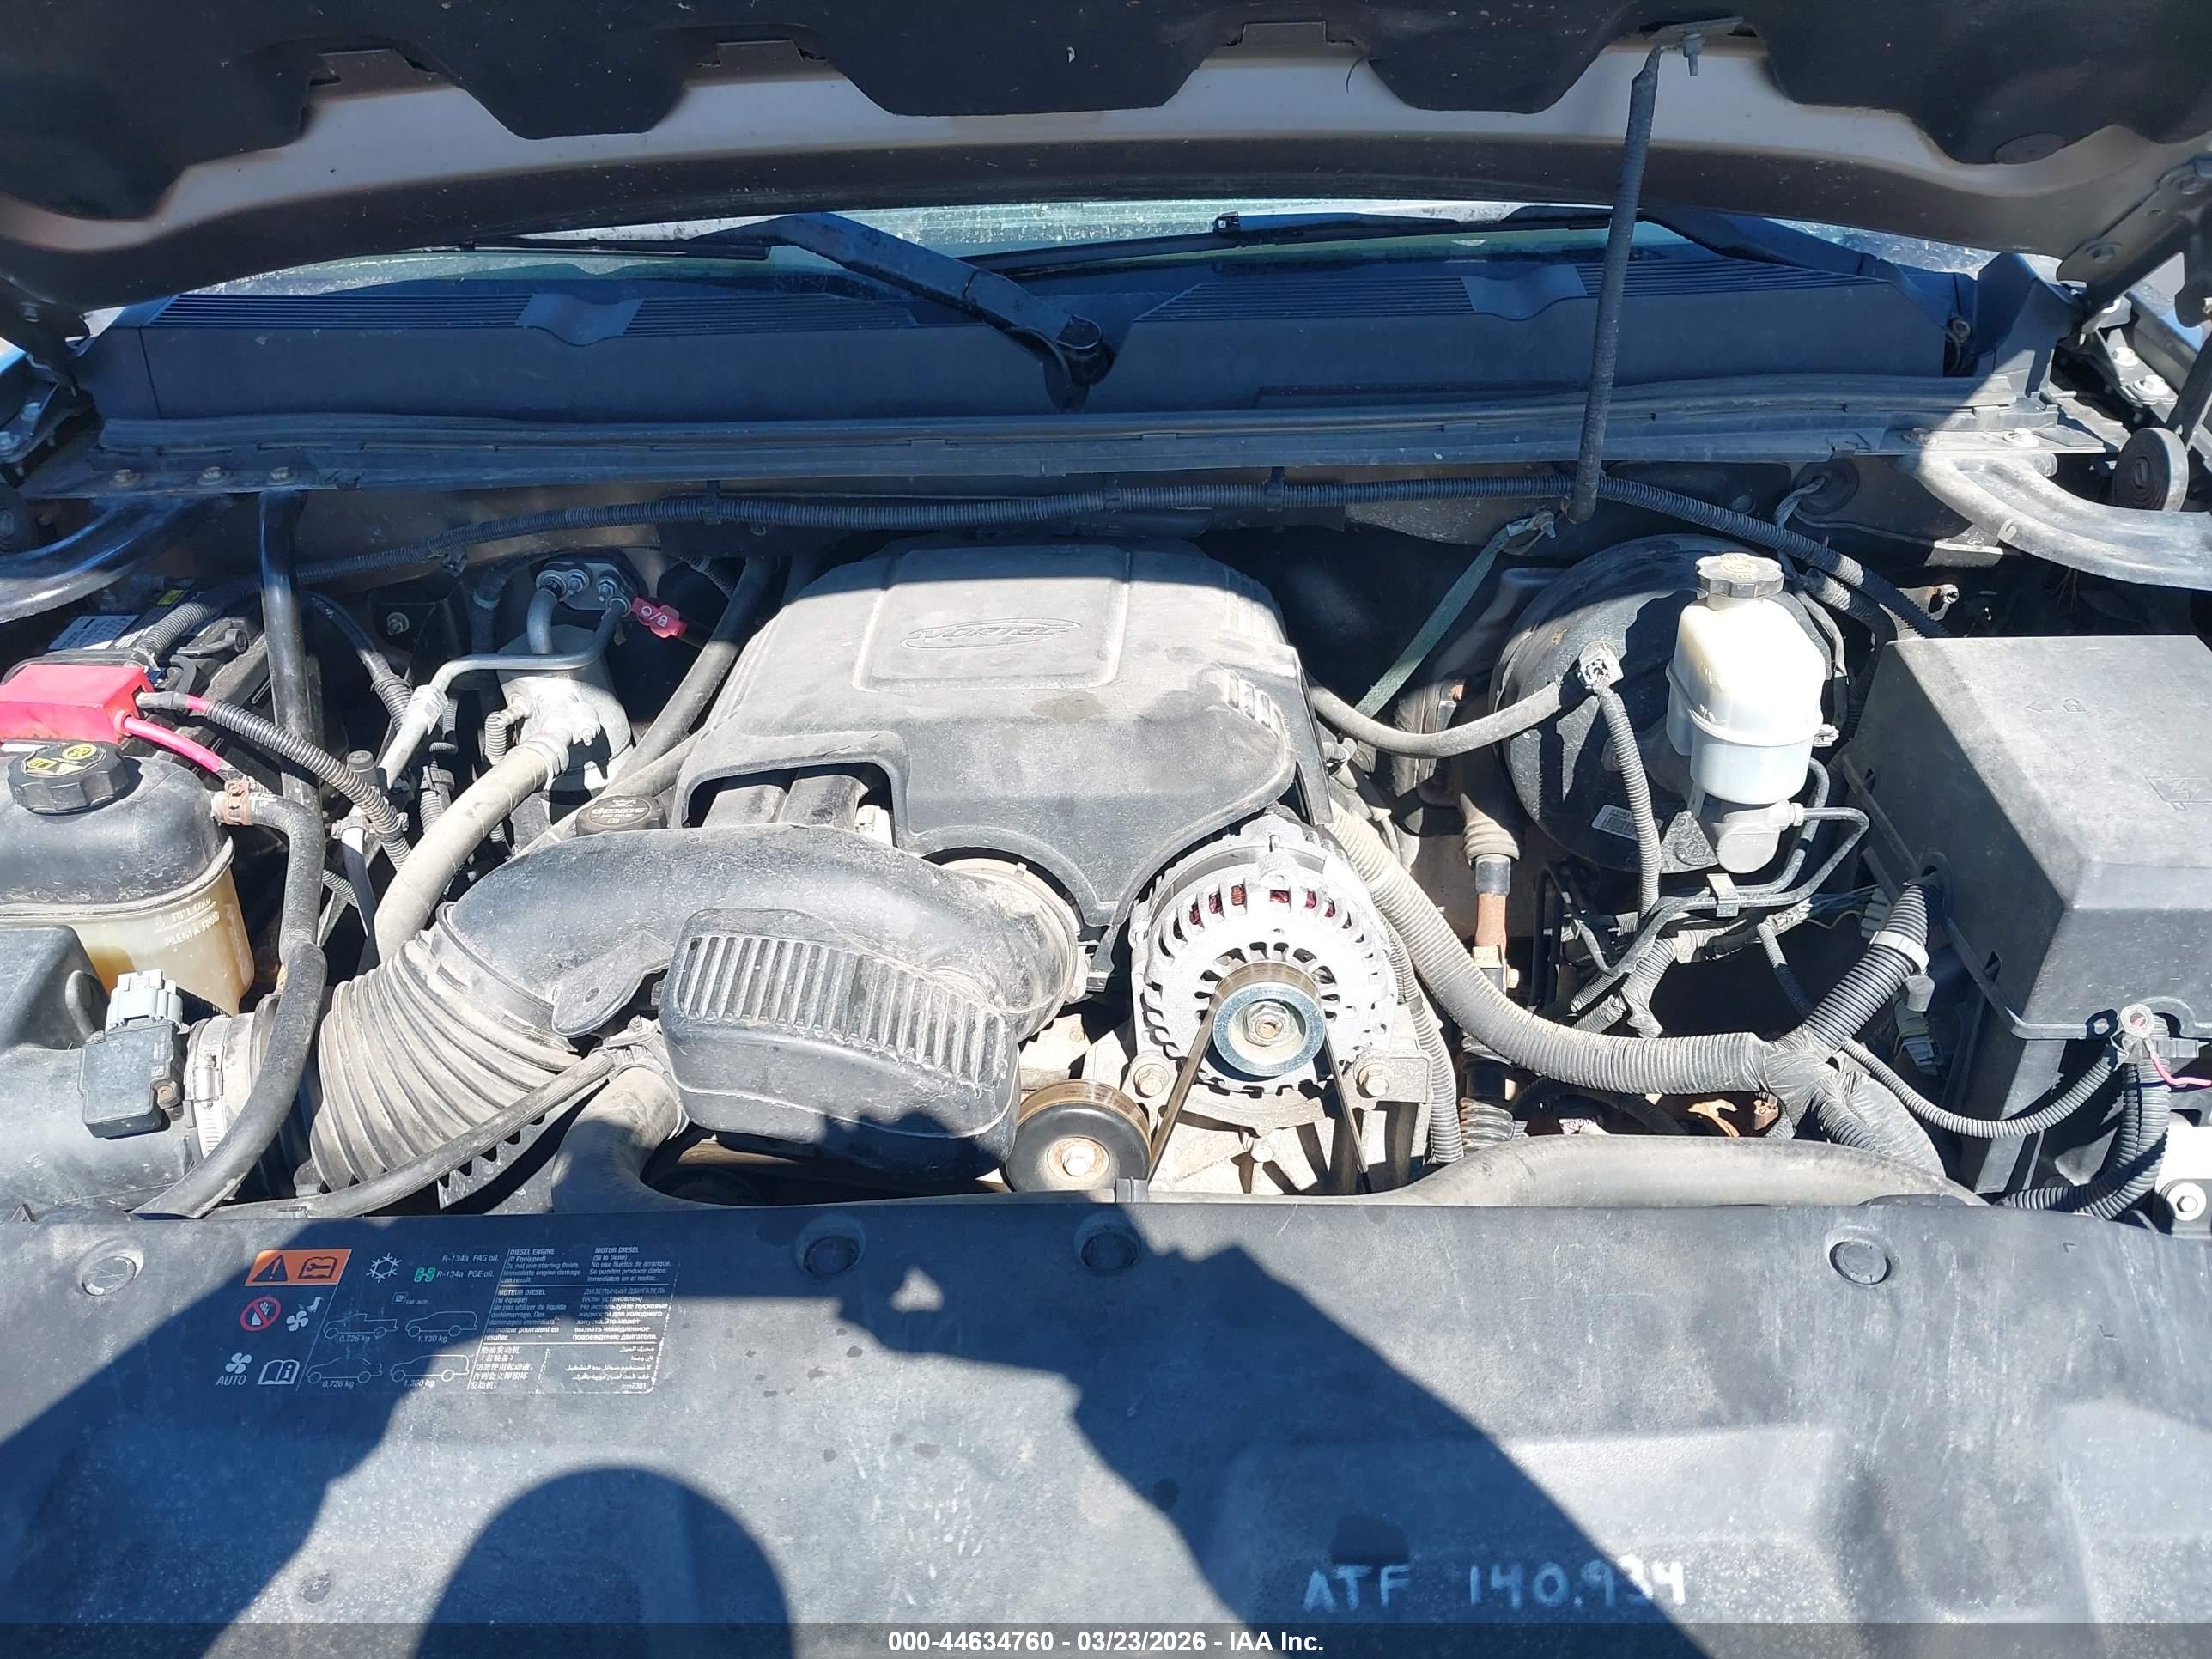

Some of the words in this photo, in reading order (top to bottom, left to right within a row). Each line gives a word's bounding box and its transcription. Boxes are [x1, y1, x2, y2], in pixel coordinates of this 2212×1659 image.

[361, 1334, 371, 1343] kg
[438, 1334, 448, 1344] kg
[215, 1375, 246, 1386] AUTO
[344, 1380, 355, 1389] kg
[424, 1379, 435, 1388] kg
[1304, 1565, 1414, 1612] ATF
